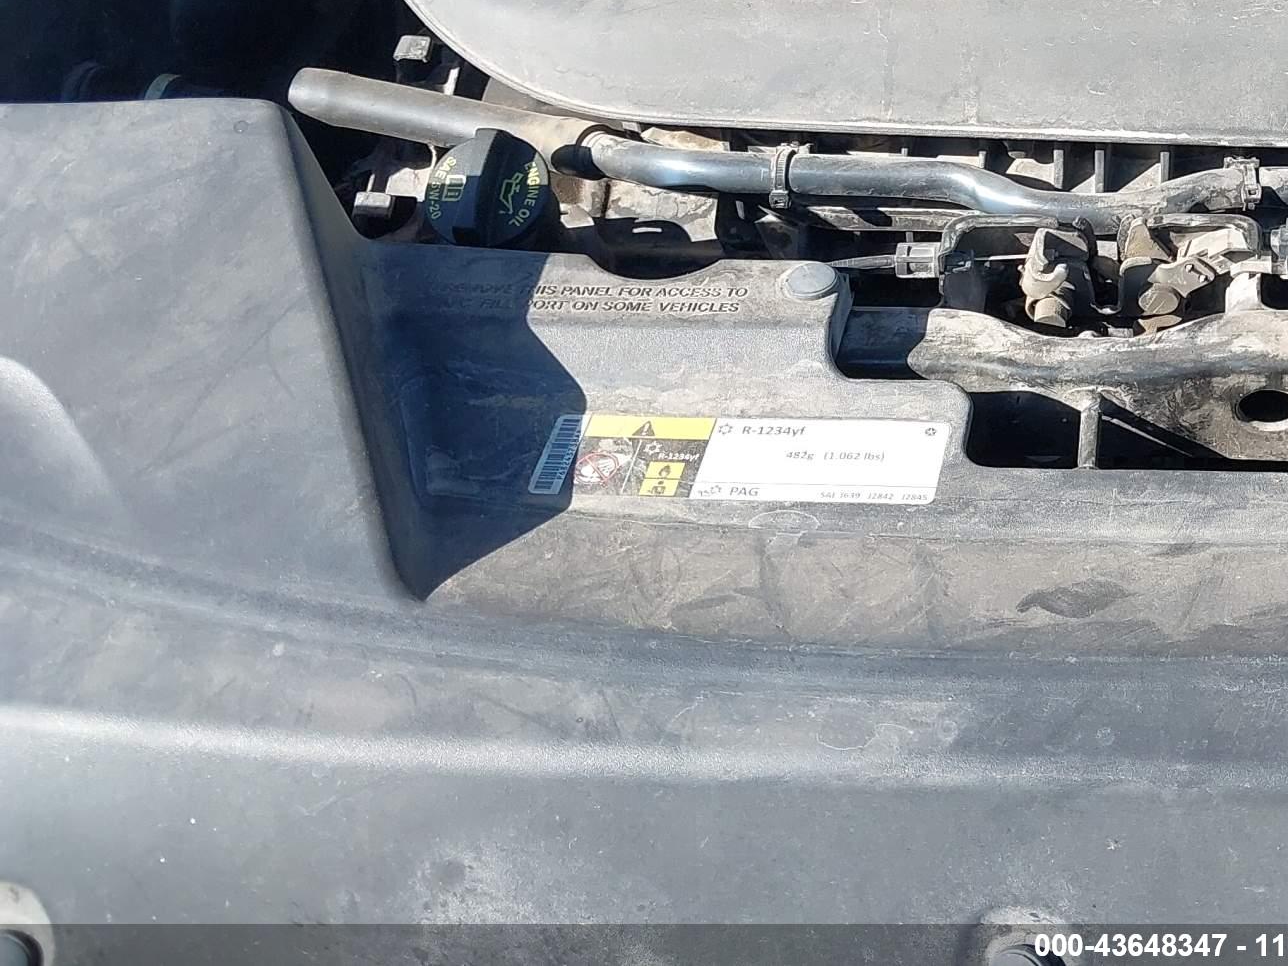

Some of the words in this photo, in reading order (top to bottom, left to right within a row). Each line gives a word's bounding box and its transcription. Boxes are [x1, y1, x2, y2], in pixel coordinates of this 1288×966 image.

[434, 156, 457, 180] SAE
[524, 161, 541, 206] ENGINE
[427, 181, 442, 220] 5W-20
[508, 208, 530, 227] OIL
[560, 286, 613, 297] PANEL
[617, 286, 653, 297] FOR
[656, 286, 722, 298] ACCESS
[727, 287, 749, 298] TO
[527, 299, 569, 311] PORT
[571, 300, 599, 311] ON
[602, 301, 653, 312] SOME
[660, 302, 740, 313] VEHICLES
[742, 425, 806, 437] R-1234yf
[786, 450, 815, 461] 482g
[824, 451, 861, 461] (1.062
[863, 451, 886, 462] lbs)
[730, 486, 759, 497] PAG
